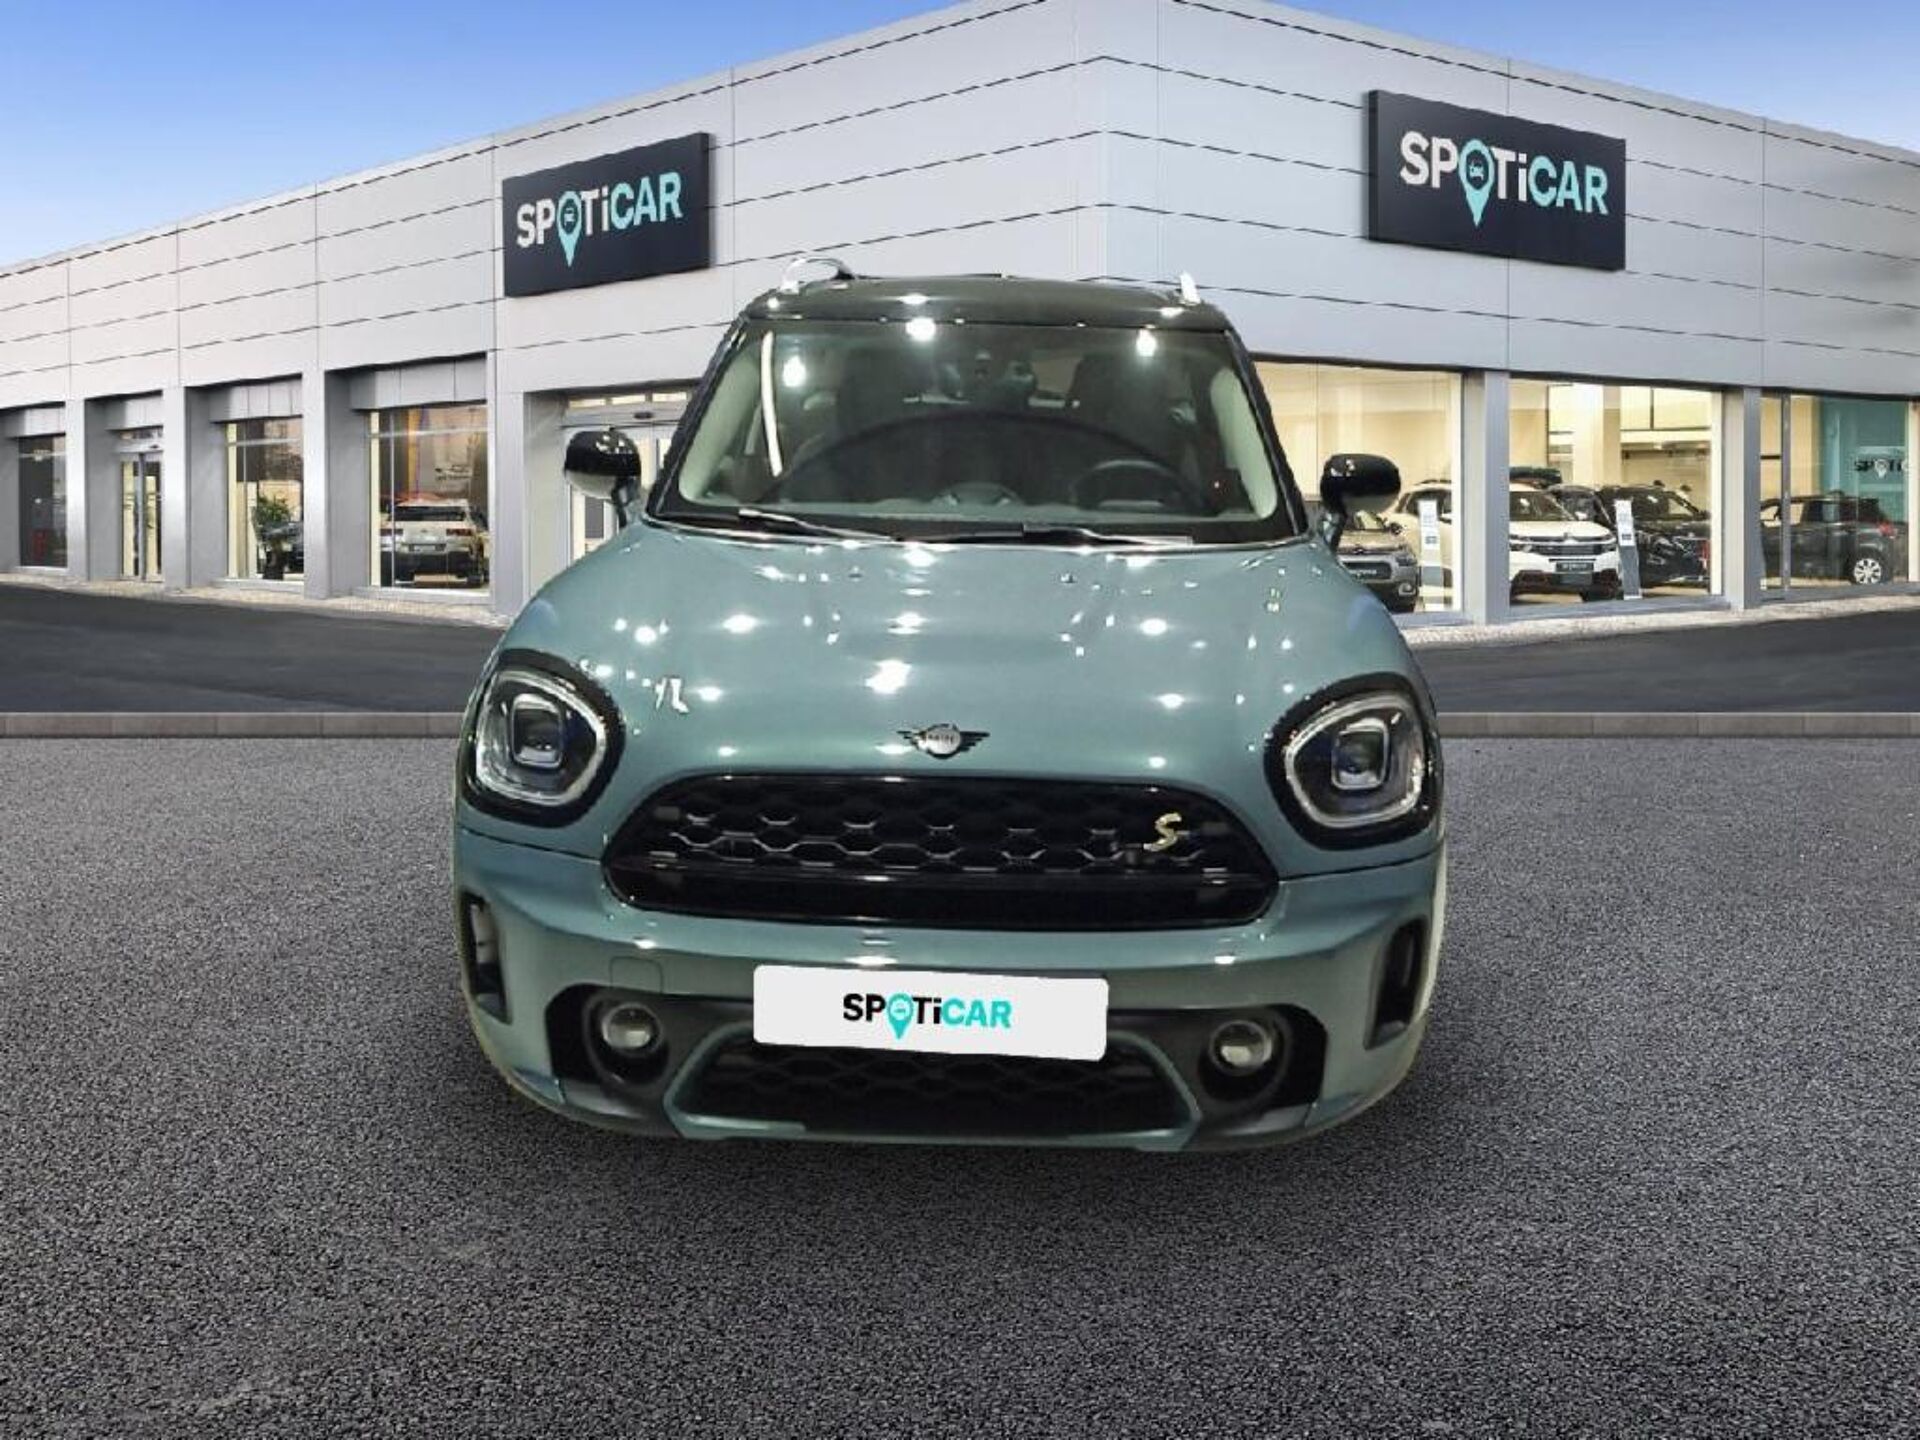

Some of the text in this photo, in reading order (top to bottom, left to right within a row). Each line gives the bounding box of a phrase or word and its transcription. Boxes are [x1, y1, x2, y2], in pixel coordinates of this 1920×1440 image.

[1400, 131, 1609, 228] SPOTiCAR
[516, 172, 684, 267] SPOTiCAR
[1143, 812, 1182, 852] S
[842, 993, 1013, 1040] SPOTiCAR
